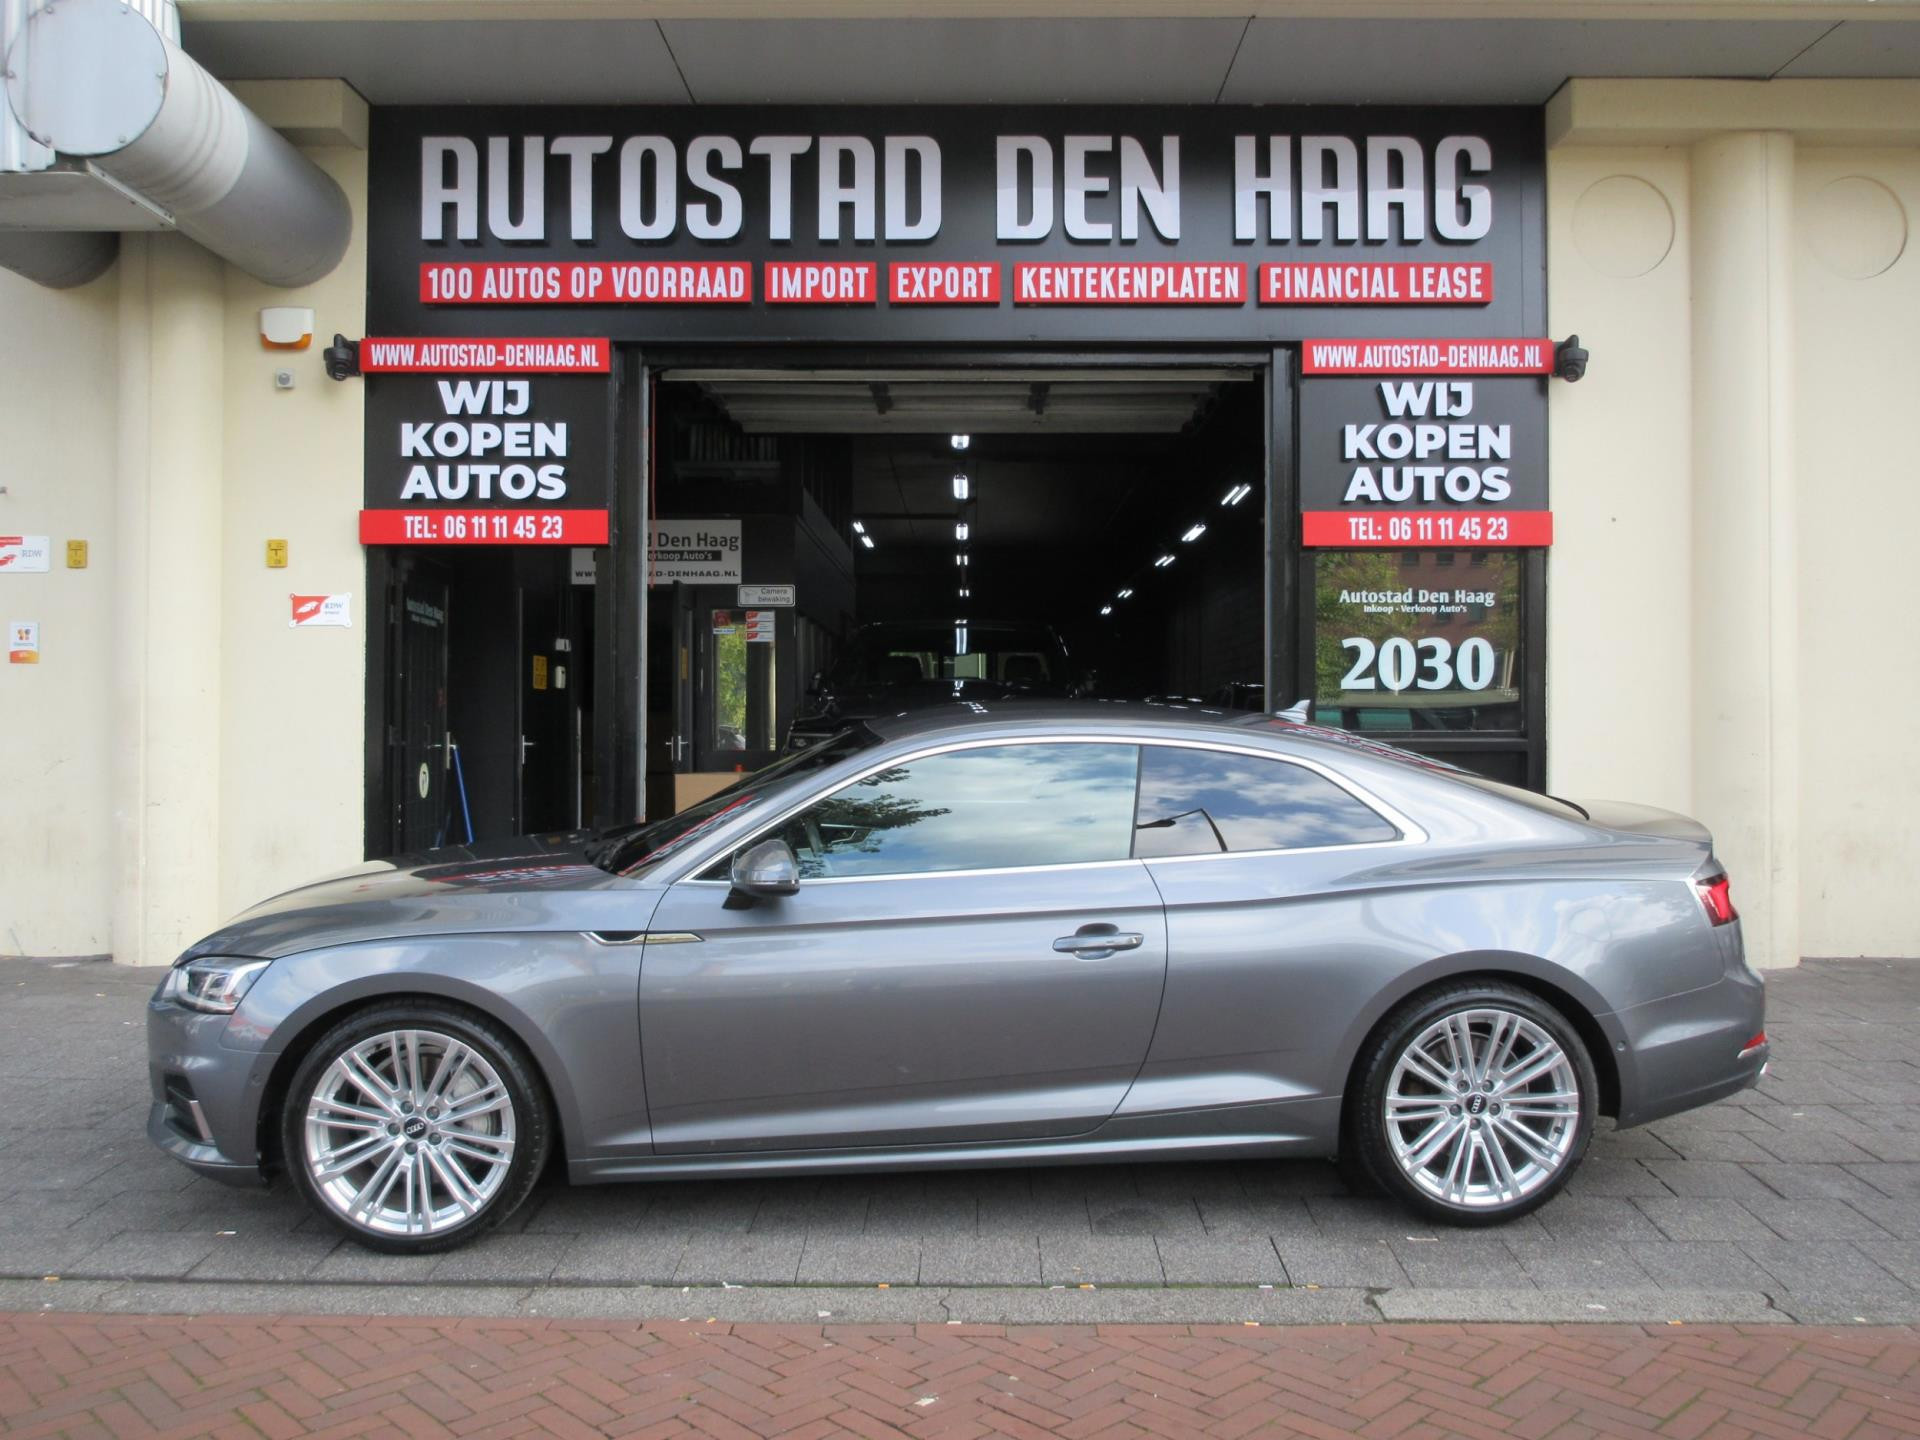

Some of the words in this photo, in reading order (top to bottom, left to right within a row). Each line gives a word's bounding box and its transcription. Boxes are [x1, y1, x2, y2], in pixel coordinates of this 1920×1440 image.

[421, 135, 941, 241] AUTOSTAD
[996, 135, 1181, 241] DEN
[1234, 135, 1492, 241] HAAG
[428, 267, 472, 299] 100
[482, 267, 560, 299] AUTOS
[572, 267, 603, 299] OP
[612, 267, 745, 299] VOORRAAD
[772, 267, 869, 299] IMPORT
[897, 267, 993, 299] EXPORT
[1022, 267, 1239, 299] KENTEKENPLATEN
[1269, 267, 1400, 299] FINANCIAL
[1410, 267, 1483, 299] LEASE
[371, 344, 599, 367] WWW.AUTOSTAD-DENHAAG.NL
[1313, 345, 1543, 368] WWW.AUTOSTAD-DENHAAG.NL
[438, 381, 530, 415] WIJ
[1381, 382, 1474, 417] WIJ
[401, 422, 567, 457] KOPEN
[1345, 424, 1511, 459] KOPEN
[400, 464, 567, 500] AUTOS
[1344, 466, 1511, 502] AUTOS
[404, 515, 438, 539] TEL:
[444, 515, 466, 539] 06
[471, 515, 487, 539] 11
[492, 515, 508, 539] 11
[513, 515, 536, 539] 45
[541, 515, 563, 539] 23
[657, 532, 691, 548] Den
[696, 532, 740, 551] Haag
[1349, 517, 1383, 541] TEL:
[1389, 517, 1412, 541] 06
[1416, 517, 1433, 541] 11
[1437, 517, 1454, 541] 11
[1458, 517, 1482, 541] 45
[1487, 517, 1508, 541] 23
[760, 587, 788, 595] Camera
[1339, 587, 1413, 603] Autostad
[1418, 589, 1450, 603] Den
[1454, 589, 1496, 607] Haag
[1363, 605, 1394, 614] Inkoop
[1401, 604, 1438, 614] Verkoop
[1439, 604, 1467, 613] Auto's
[1340, 637, 1495, 690] 2030
